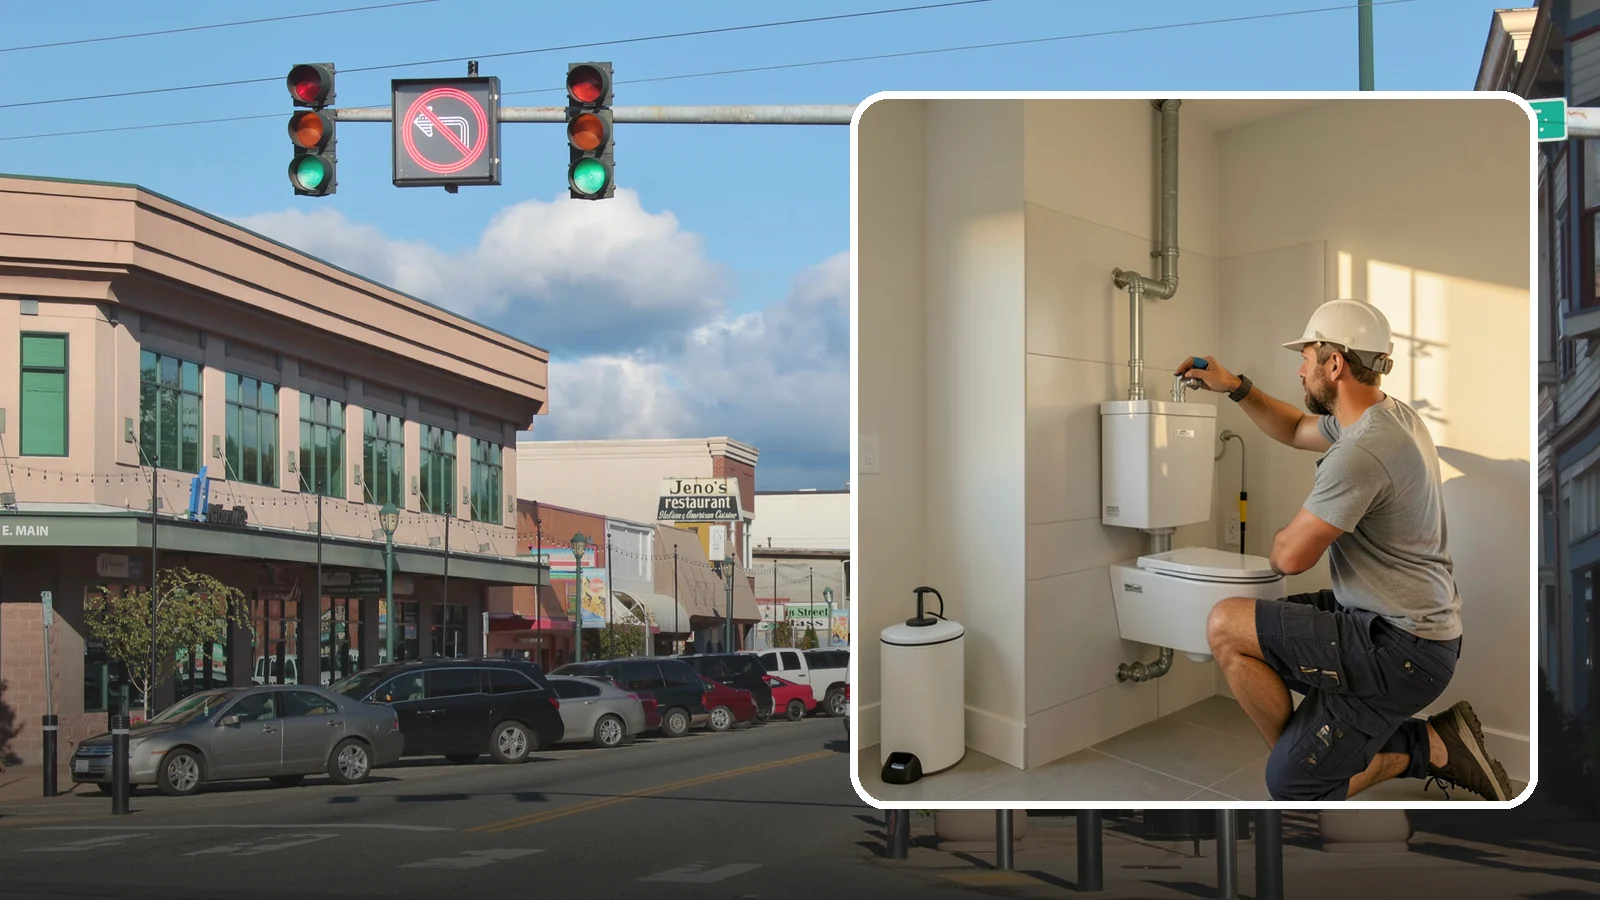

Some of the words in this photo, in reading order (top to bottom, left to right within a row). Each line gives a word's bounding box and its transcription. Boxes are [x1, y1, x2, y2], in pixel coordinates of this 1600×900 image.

[670, 480, 727, 494] Jeno's
[665, 496, 731, 509] restaurant
[659, 510, 681, 519] Italian
[686, 510, 714, 519] American
[715, 509, 737, 519] Cuisine
[2, 525, 13, 536] E.
[15, 525, 49, 536] MAIN
[797, 607, 829, 617] Street
